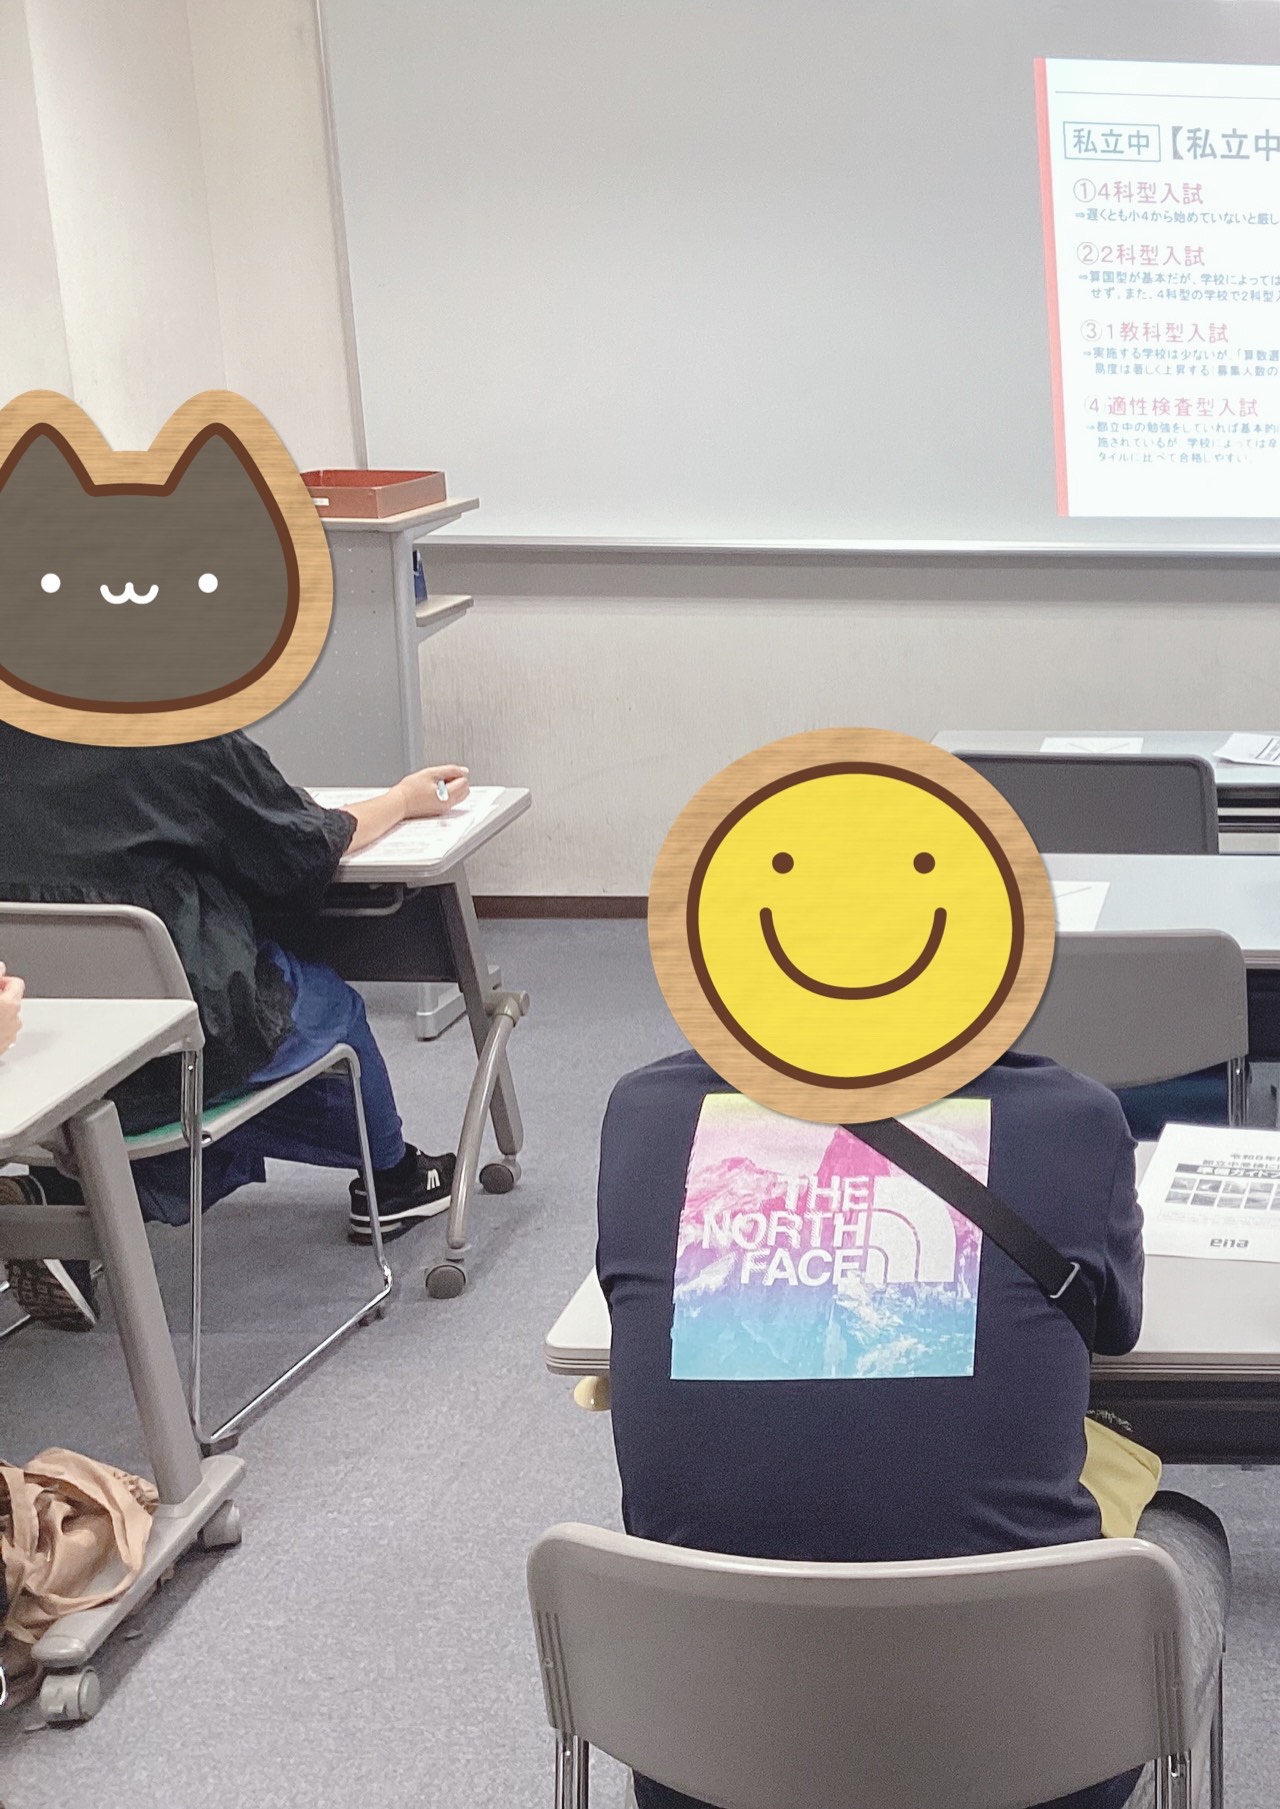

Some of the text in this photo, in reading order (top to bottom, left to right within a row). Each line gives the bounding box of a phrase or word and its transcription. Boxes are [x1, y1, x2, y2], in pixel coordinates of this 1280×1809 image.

[1072, 127, 1151, 156] 私立中
[1072, 178, 1204, 205] ①4科型入試
[1076, 242, 1206, 268] ②2科型入試
[1080, 319, 1229, 344] ③1教科型入試
[777, 1175, 870, 1212] THE
[701, 1210, 867, 1249] NORTH
[1209, 1237, 1249, 1249] ena
[740, 1248, 863, 1286] FACE
